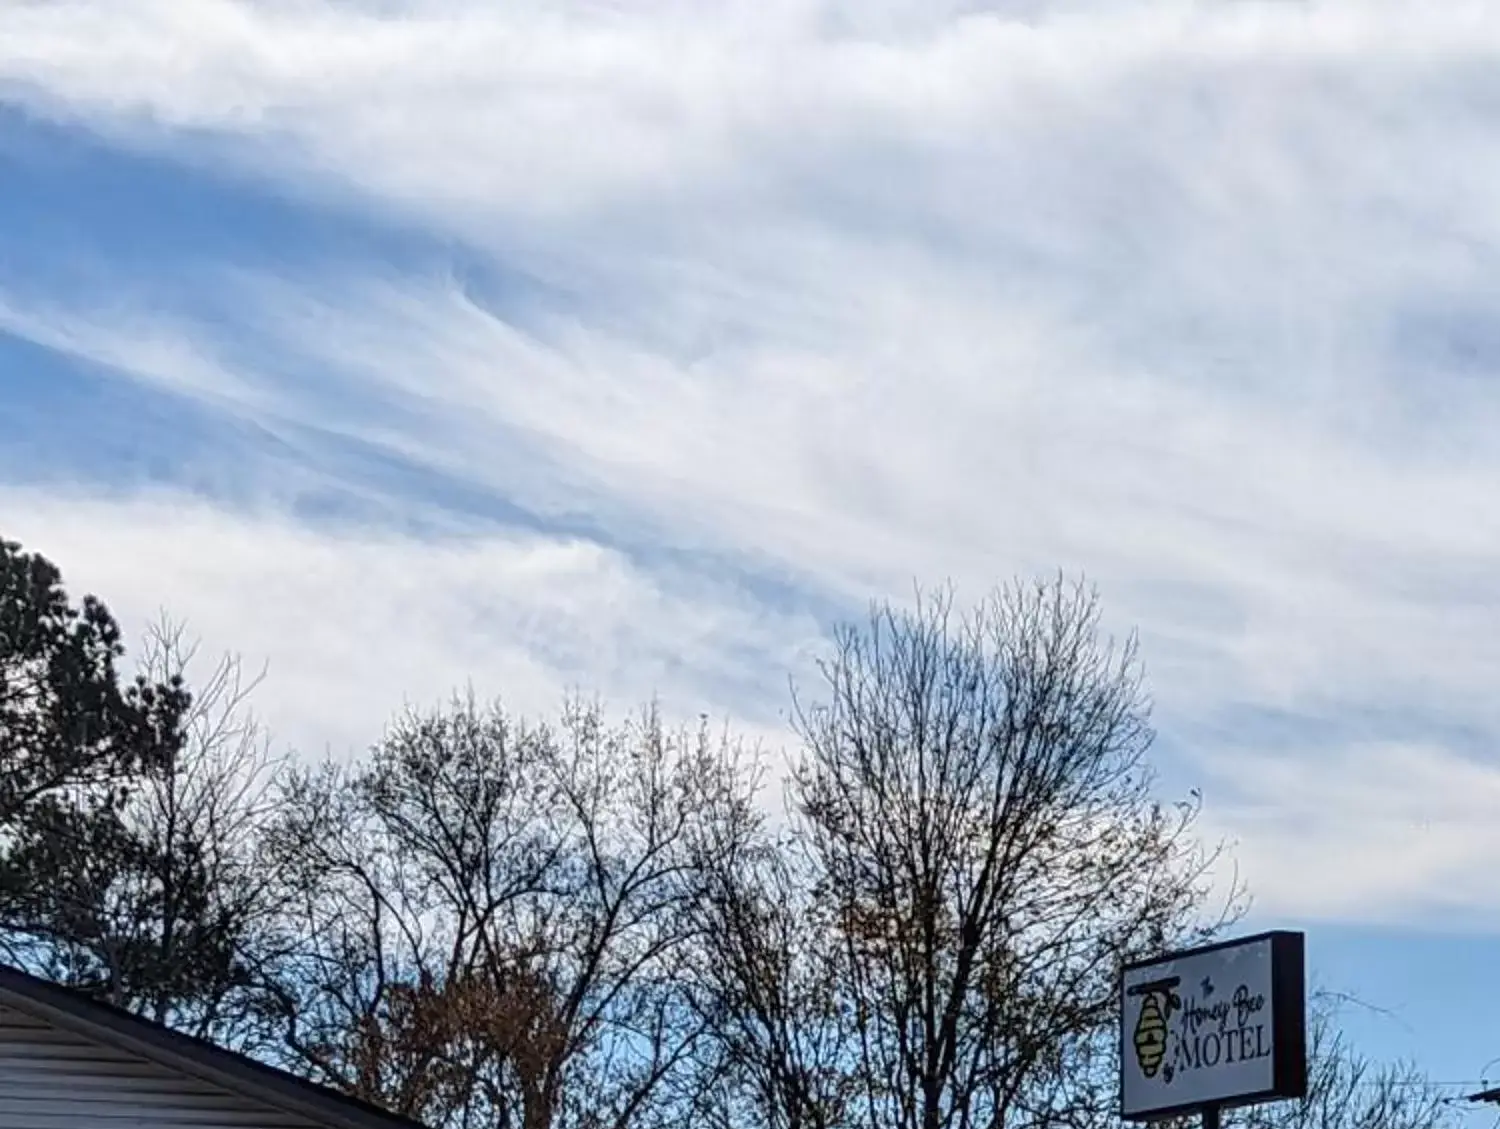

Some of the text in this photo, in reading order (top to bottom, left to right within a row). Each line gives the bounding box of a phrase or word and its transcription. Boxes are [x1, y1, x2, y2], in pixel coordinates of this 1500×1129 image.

[1180, 983, 1265, 1040] Honey Bee
[1179, 1024, 1270, 1072] MOTEL
